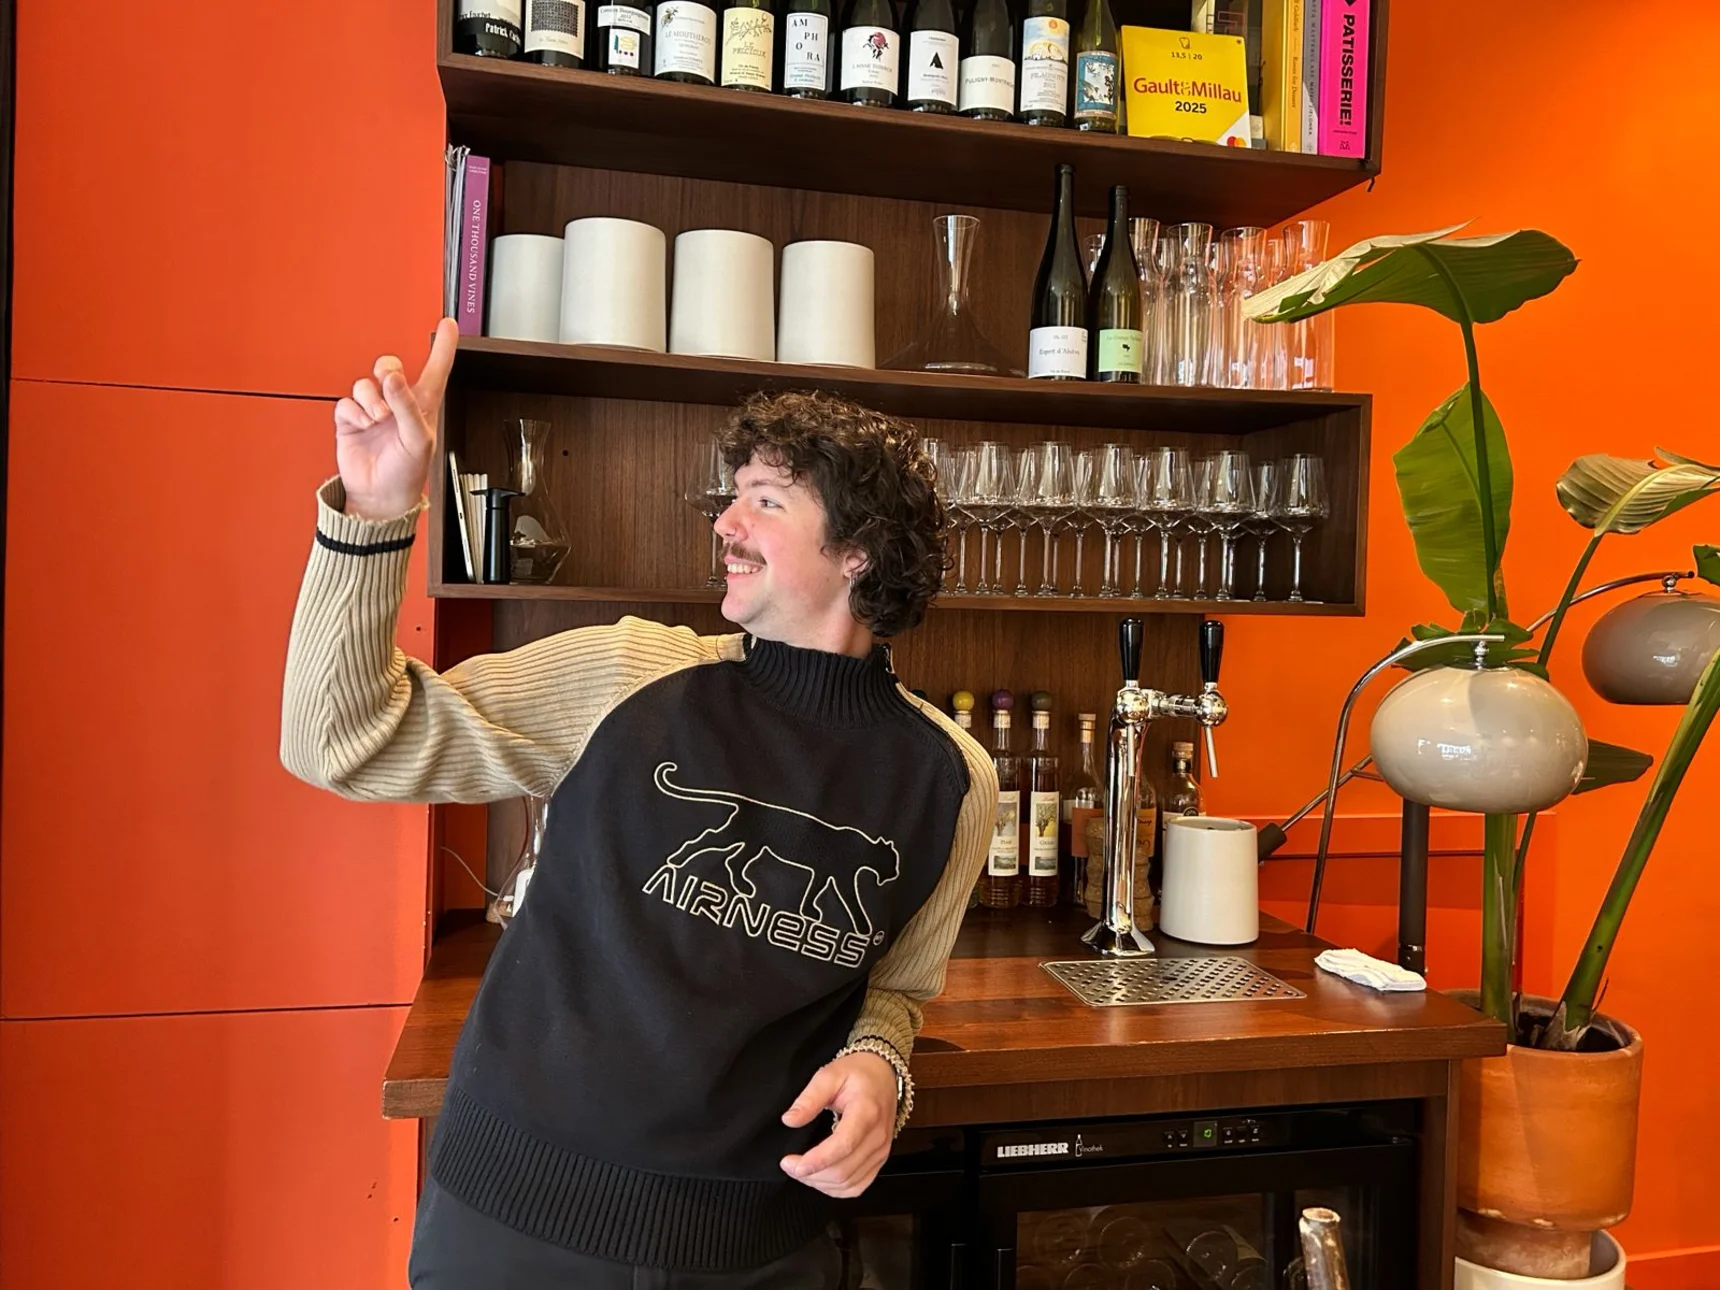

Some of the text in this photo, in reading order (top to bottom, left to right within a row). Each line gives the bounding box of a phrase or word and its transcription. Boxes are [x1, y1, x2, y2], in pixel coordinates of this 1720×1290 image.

[1339, 14, 1356, 127] PATISSERIE!
[1175, 100, 1207, 114] 2025
[467, 200, 482, 314] ONE THOUSAND VINES
[997, 1142, 1069, 1158] LIEBHERR
